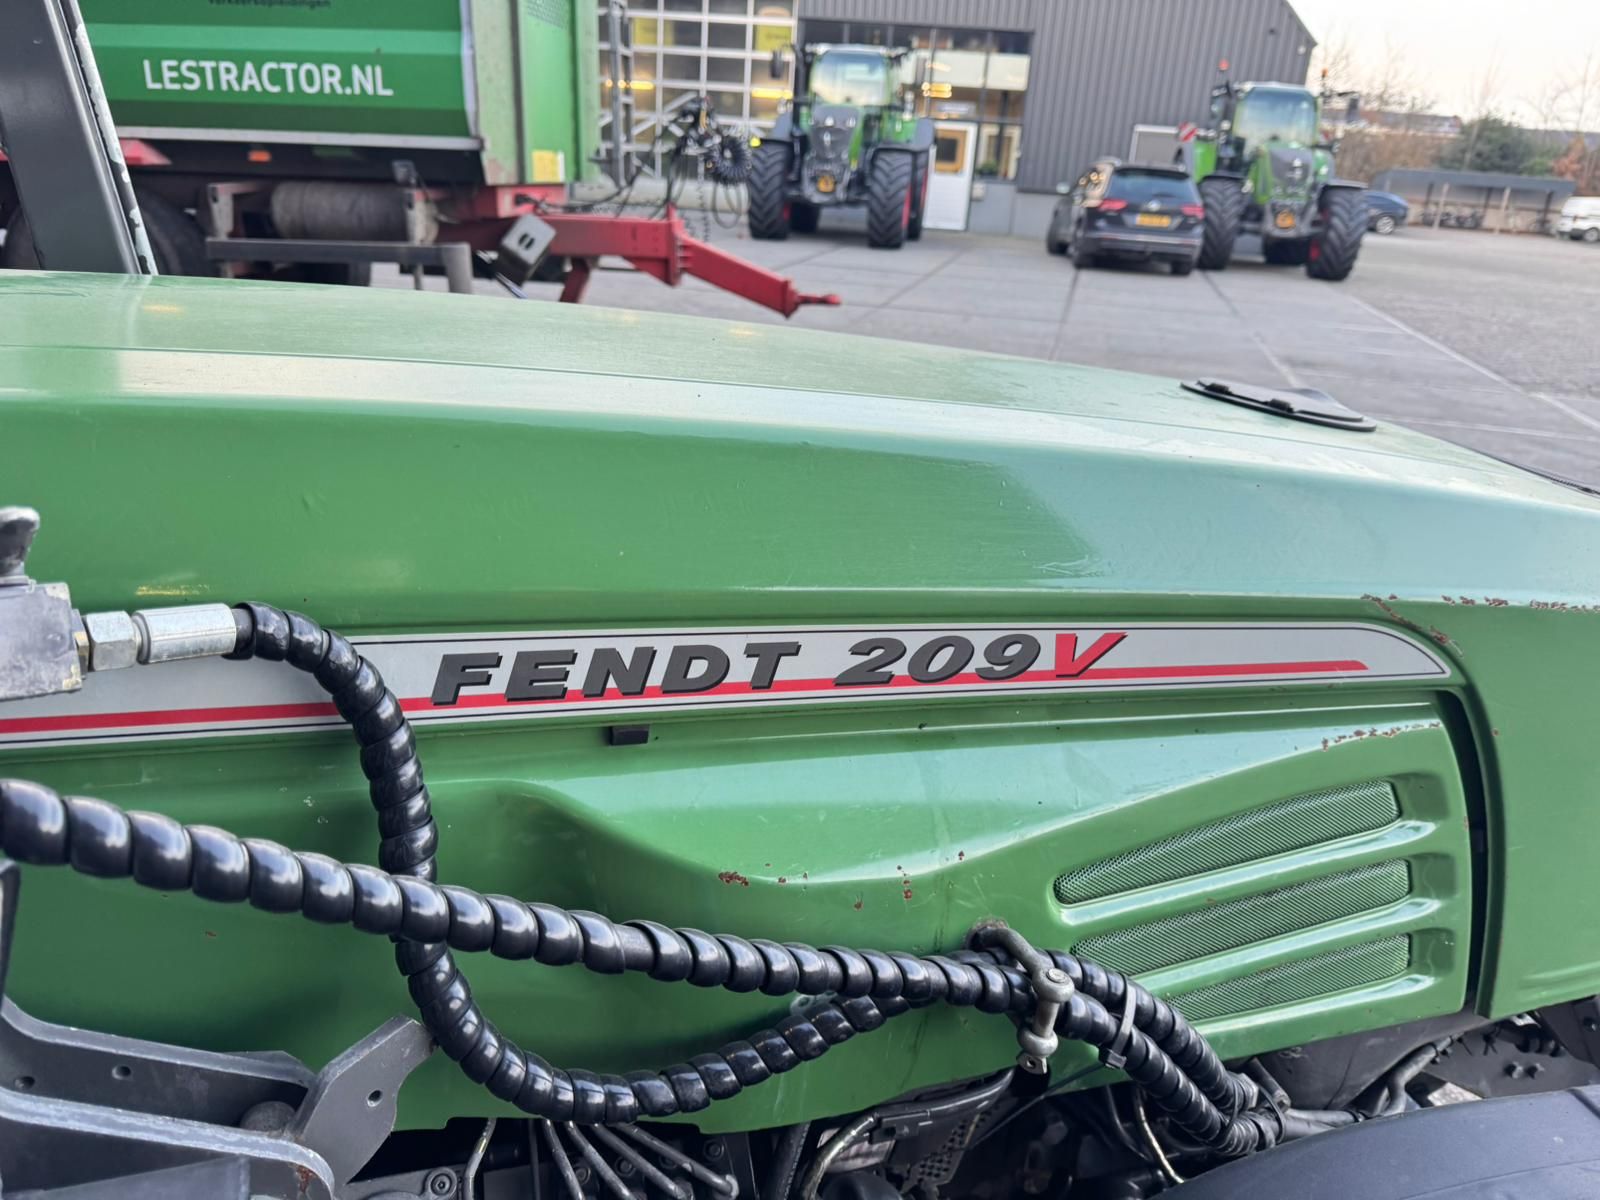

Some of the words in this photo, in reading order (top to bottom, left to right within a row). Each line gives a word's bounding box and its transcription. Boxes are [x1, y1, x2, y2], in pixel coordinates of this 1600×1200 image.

[143, 59, 394, 97] LESTRACTOR.NL
[432, 641, 801, 706] FENDT
[833, 632, 1128, 687] 209V
